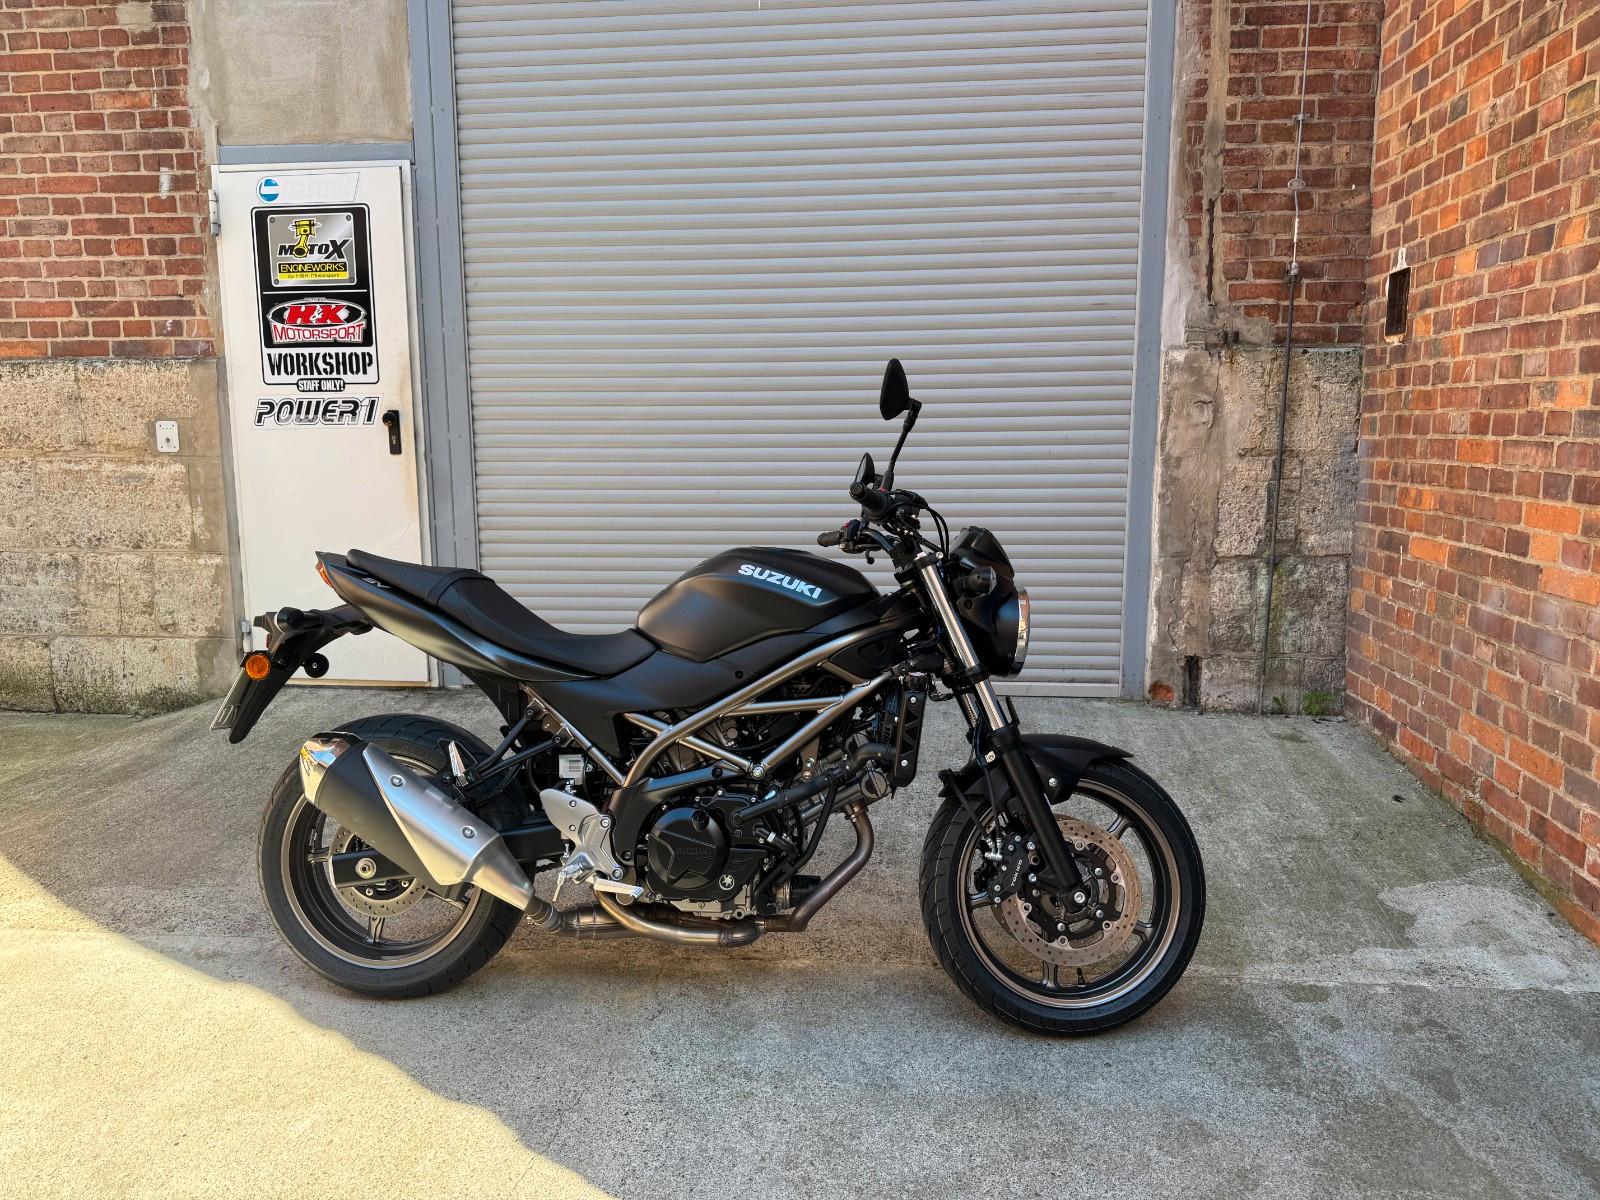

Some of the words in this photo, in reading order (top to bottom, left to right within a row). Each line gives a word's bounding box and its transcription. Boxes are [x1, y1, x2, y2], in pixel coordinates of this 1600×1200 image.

[280, 263, 345, 272] ENGINEWORKS
[286, 304, 347, 325] H&K
[272, 322, 364, 341] MOTORSPORT
[267, 352, 373, 376] WORKSHOP
[298, 380, 319, 391] STAFF
[321, 379, 344, 391] ONLY!
[255, 397, 379, 425] POWER1
[738, 564, 822, 599] SUZUKI
